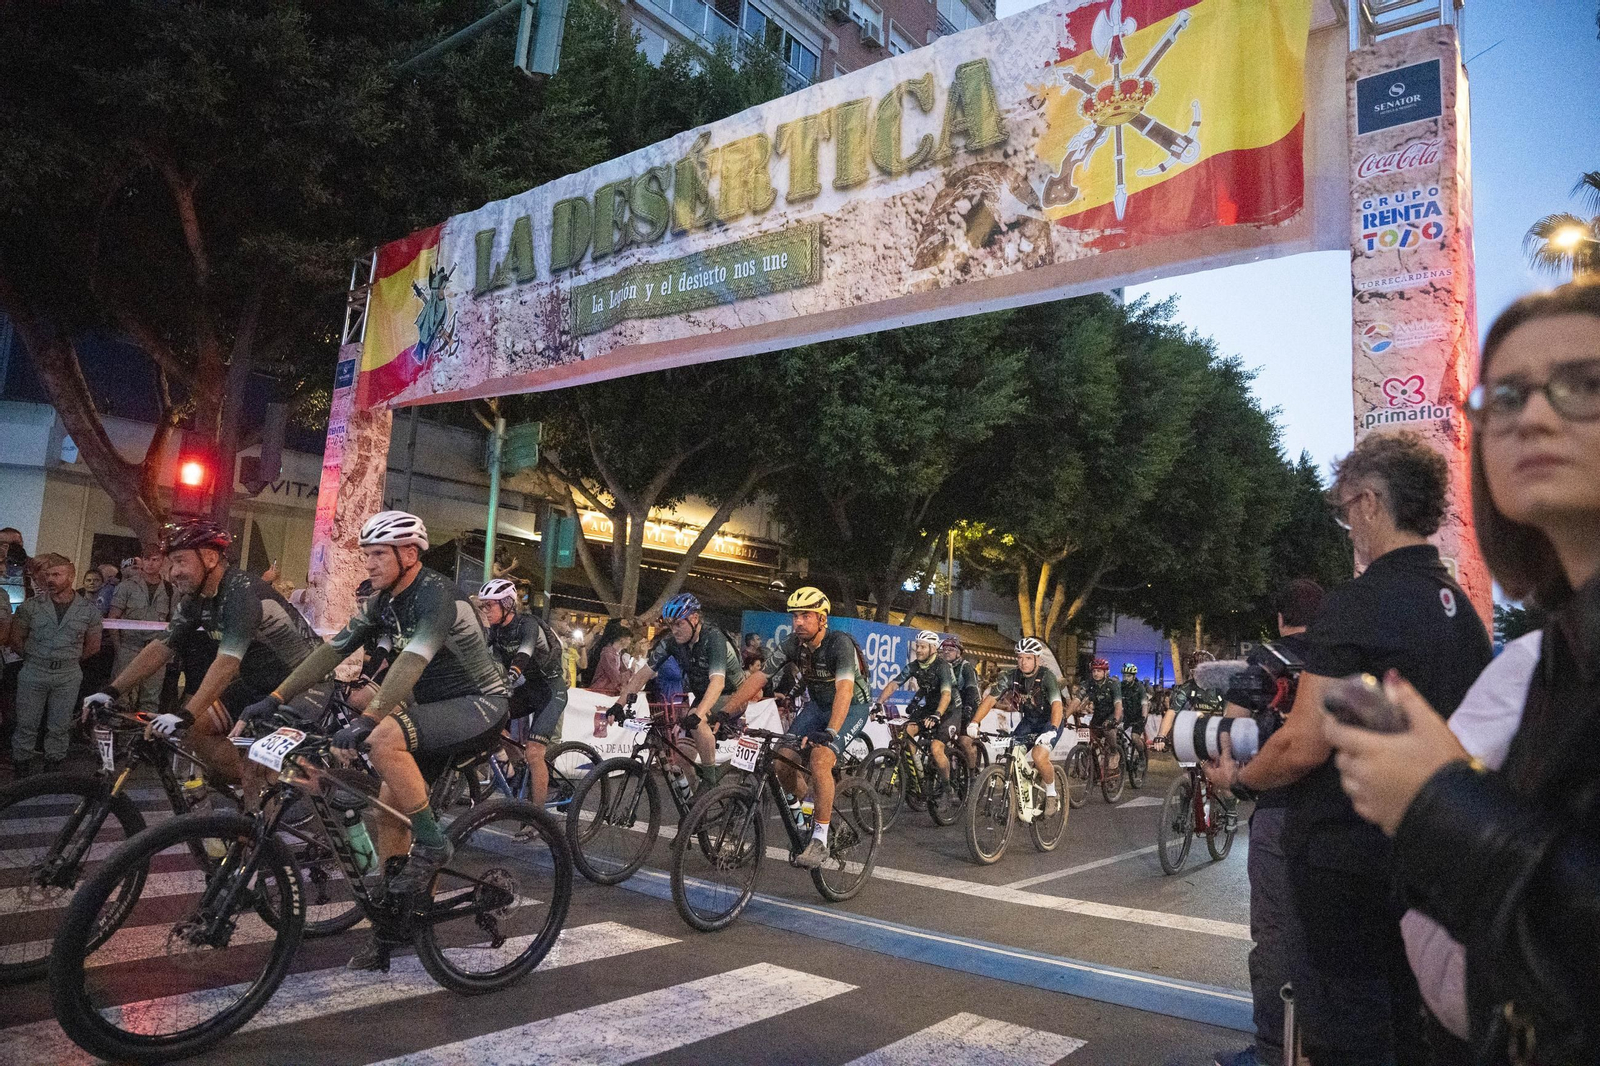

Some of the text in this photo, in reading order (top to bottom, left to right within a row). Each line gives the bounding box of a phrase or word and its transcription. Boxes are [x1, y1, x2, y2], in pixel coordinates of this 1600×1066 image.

[1374, 94, 1421, 112] SENATOR
[474, 57, 1011, 297] LA DESÉRTICA
[1363, 187, 1439, 210] GRUPO
[1363, 200, 1443, 230] RENTA
[1363, 221, 1443, 251] TODO
[591, 252, 788, 314] La Legión y el desierto nos une
[1365, 405, 1453, 429] primaflor
[606, 743, 617, 754] DE
[736, 745, 757, 762] 5107
